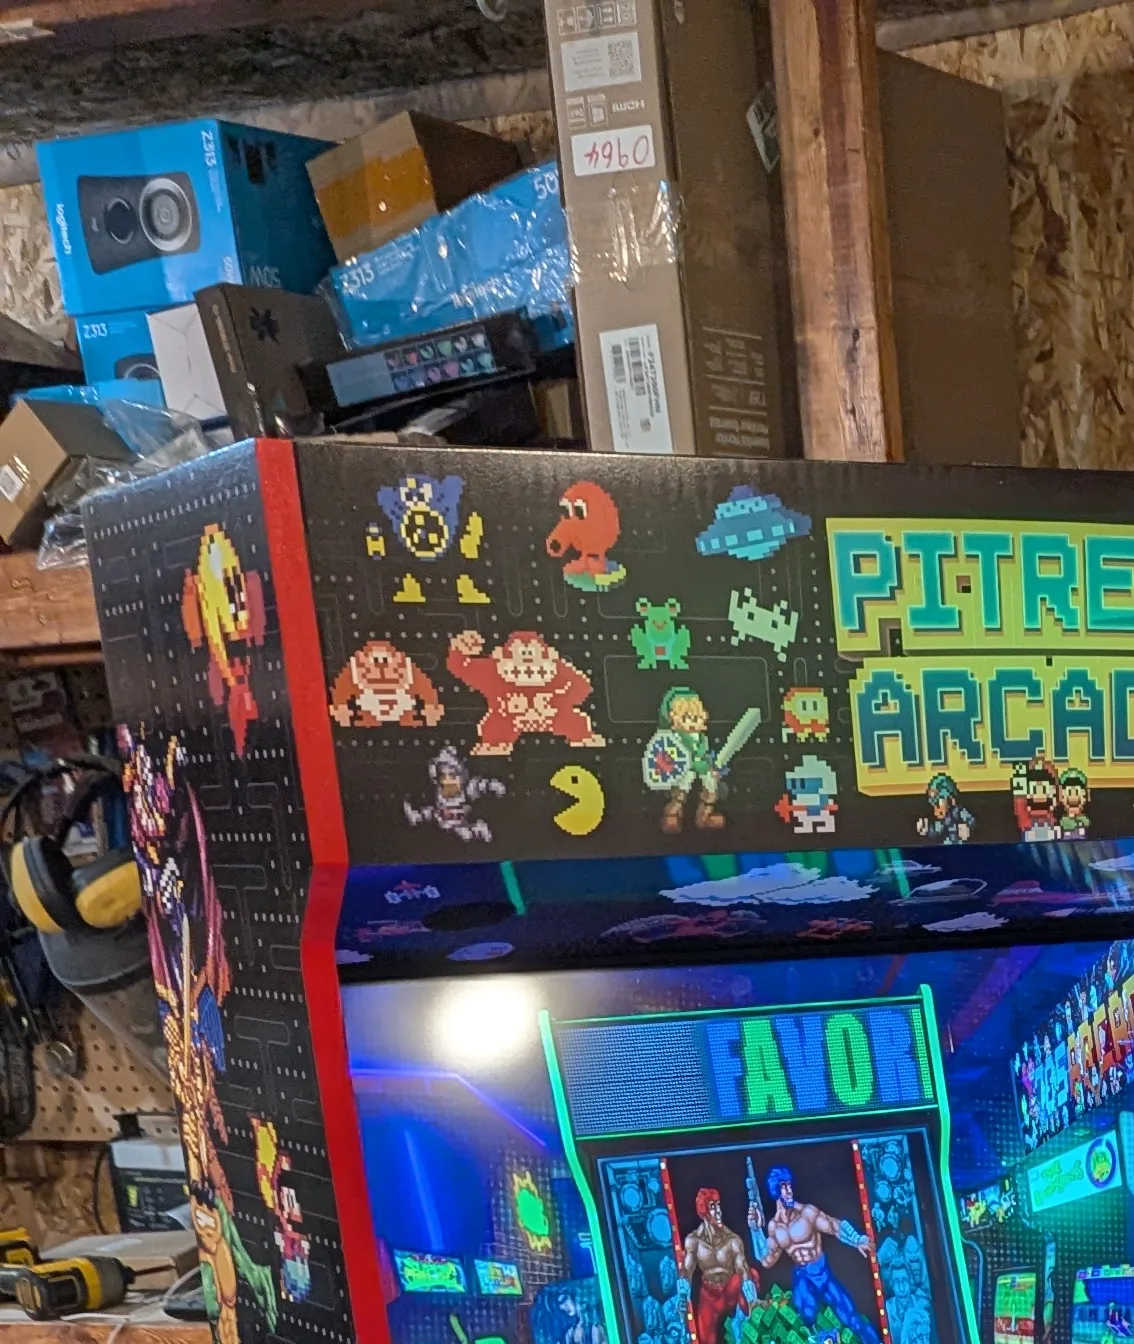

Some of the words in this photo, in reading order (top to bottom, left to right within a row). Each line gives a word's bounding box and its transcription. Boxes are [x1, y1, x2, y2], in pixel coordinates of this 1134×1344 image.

[200, 129, 217, 168] Z313
[535, 172, 559, 200] 50
[55, 203, 73, 255] logitech
[83, 322, 108, 339] Z313
